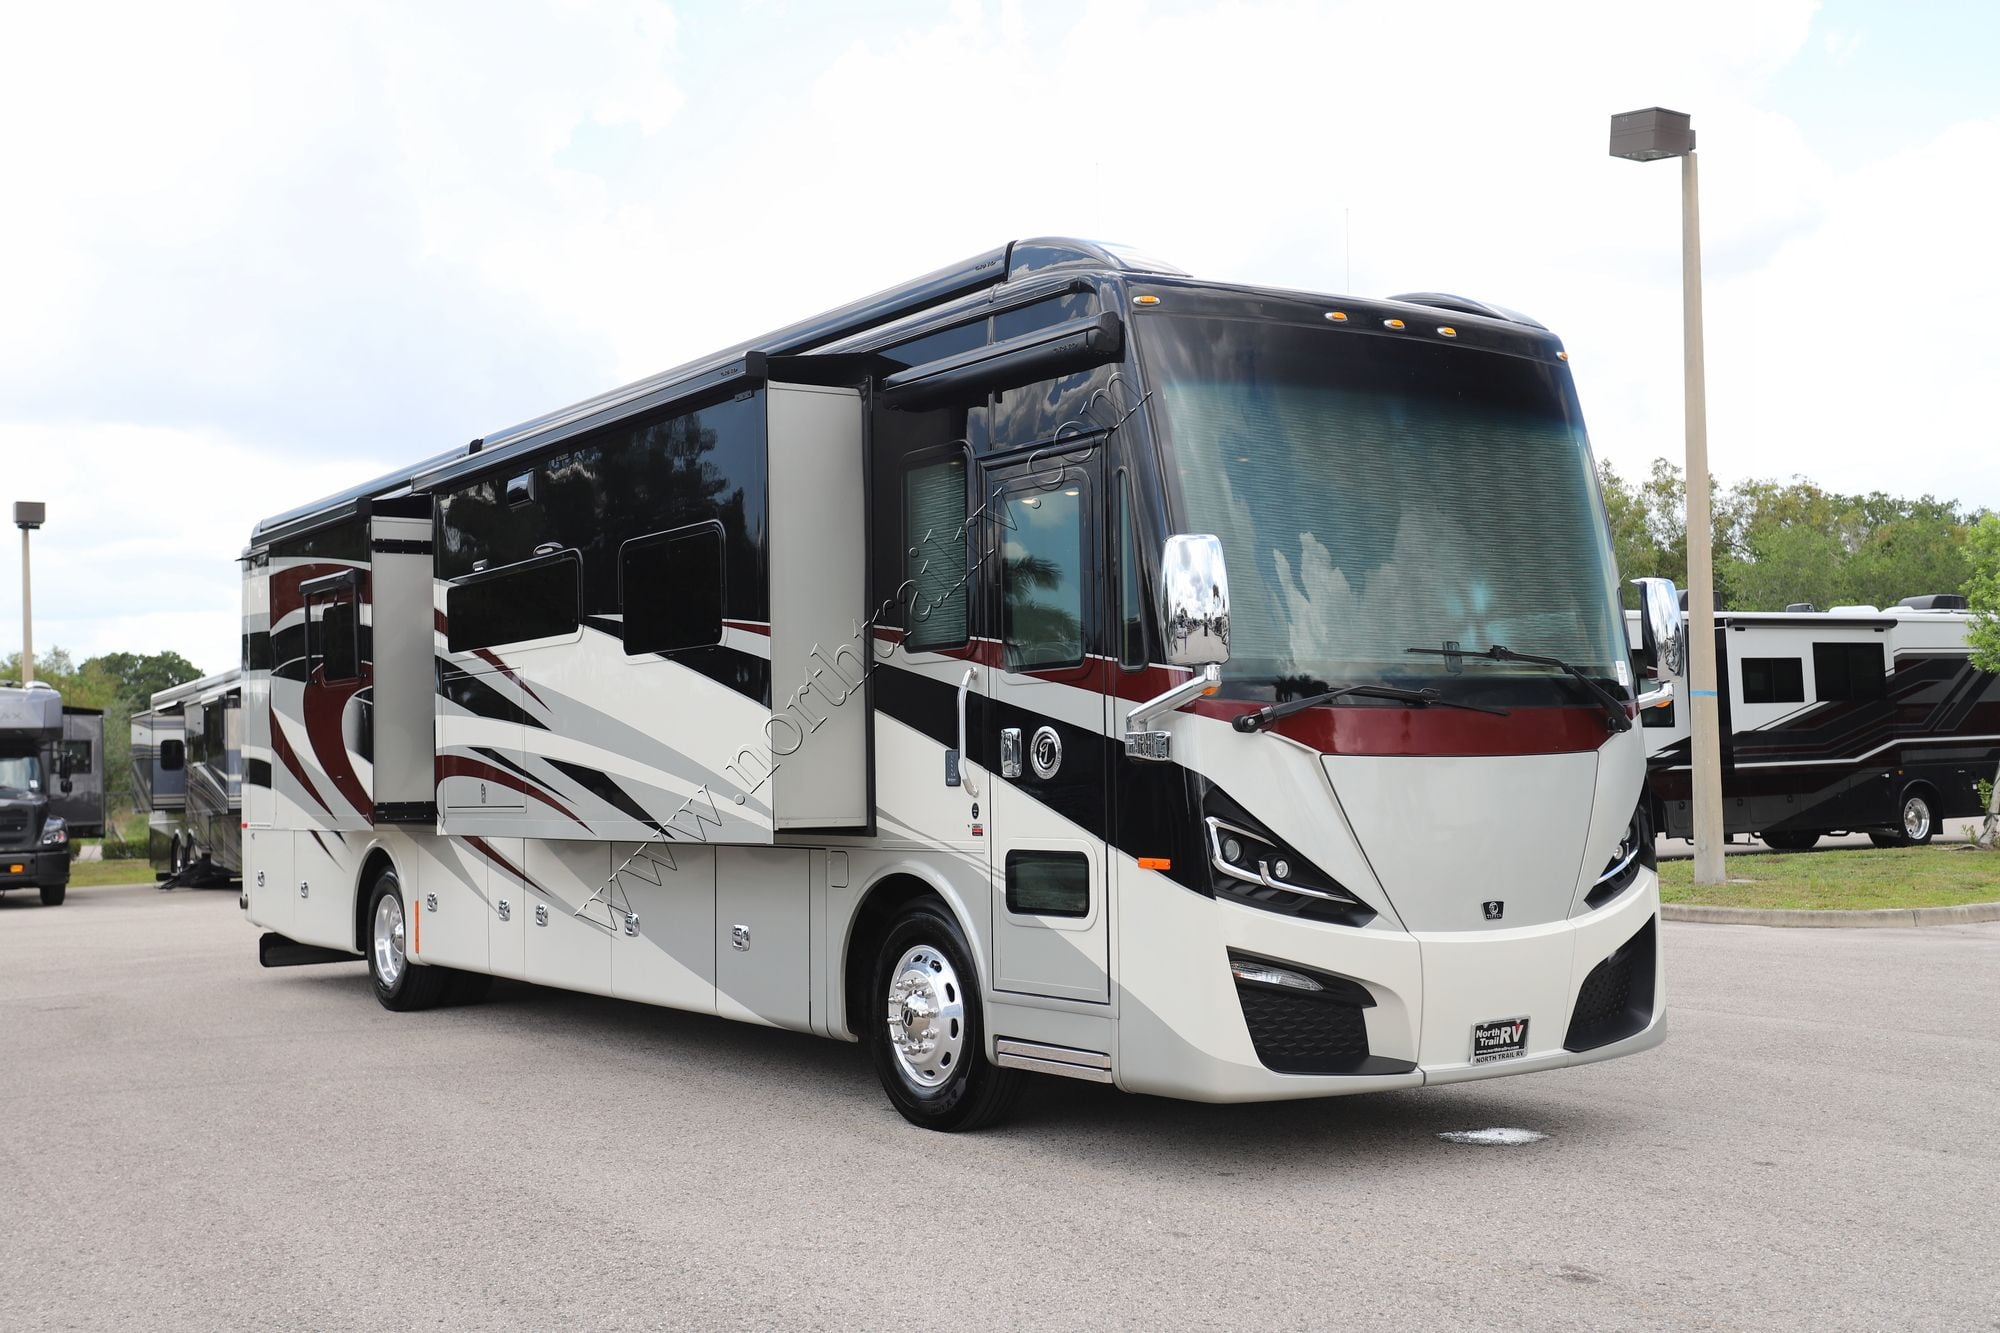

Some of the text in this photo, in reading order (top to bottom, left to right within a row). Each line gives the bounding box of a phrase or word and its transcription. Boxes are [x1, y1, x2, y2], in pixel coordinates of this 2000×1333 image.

[1476, 1028, 1500, 1039] North
[1500, 1025, 1524, 1045] RV
[1480, 1036, 1500, 1047] Trail
[1476, 1055, 1497, 1064] NORTH
[1498, 1052, 1515, 1060] TRAIL
